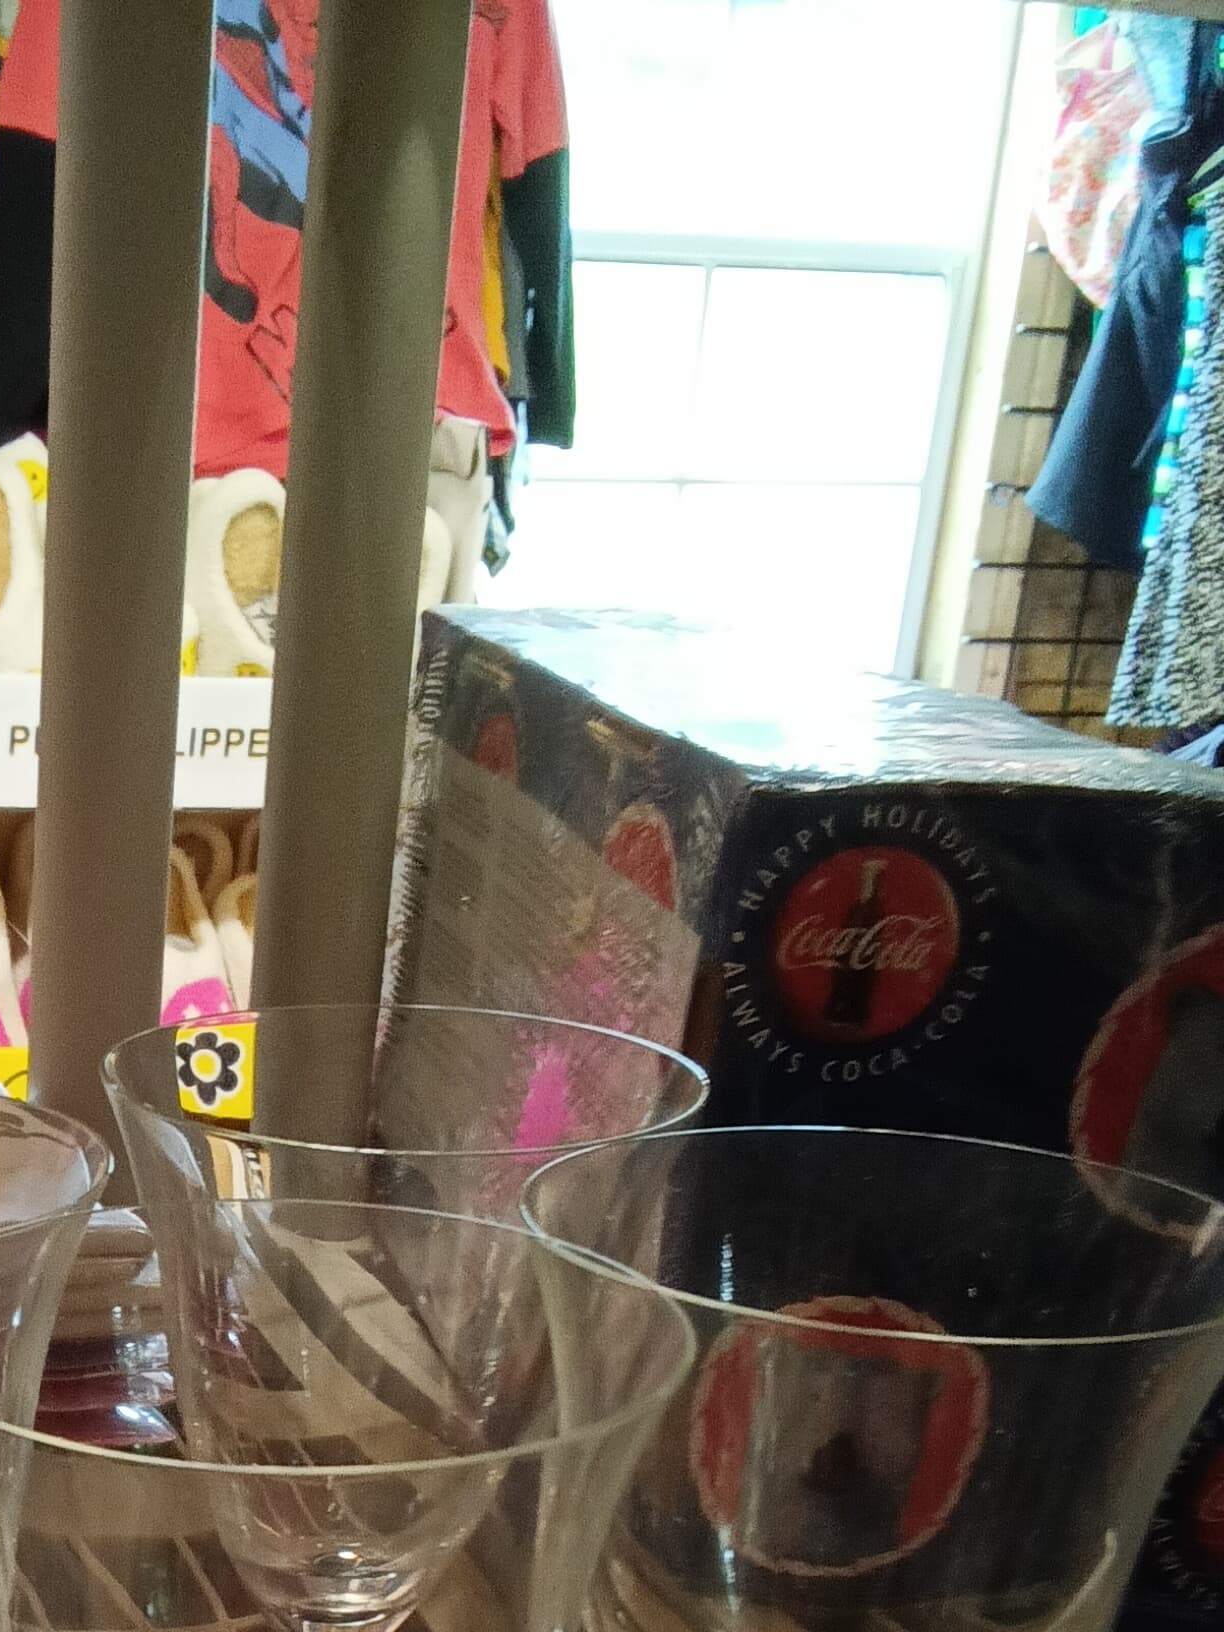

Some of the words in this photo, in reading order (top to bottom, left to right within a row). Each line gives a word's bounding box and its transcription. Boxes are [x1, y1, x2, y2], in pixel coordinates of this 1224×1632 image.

[736, 814, 835, 911] HAPPY
[862, 802, 996, 904] HOLIDAYS
[722, 960, 805, 1074] ALWAYS
[820, 964, 992, 1083] COCA-COLA
